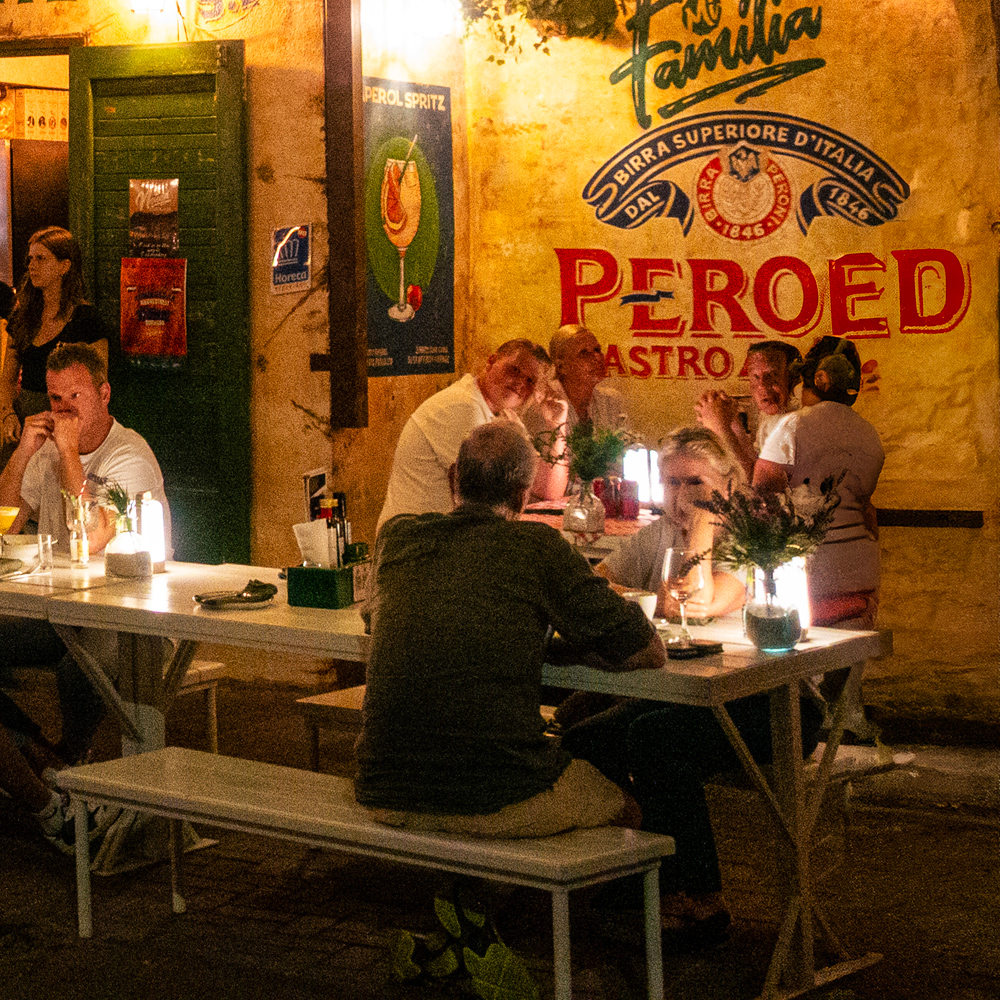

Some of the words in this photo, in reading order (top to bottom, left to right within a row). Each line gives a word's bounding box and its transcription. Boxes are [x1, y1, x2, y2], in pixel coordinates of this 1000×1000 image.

[363, 86, 403, 107] PEROL
[404, 91, 446, 112] SPRITZ
[613, 140, 672, 186] BIRRA
[674, 124, 788, 150] SUPERIORE
[795, 133, 876, 182] D'ITALIA
[624, 191, 661, 219] DAL
[699, 166, 720, 221] BIRRA
[765, 163, 791, 224] PERONI
[828, 187, 872, 222] 1846
[720, 225, 765, 240] 1846
[275, 271, 307, 284] Horeca
[554, 247, 970, 338] PEROED
[605, 344, 732, 380] ASTRO
